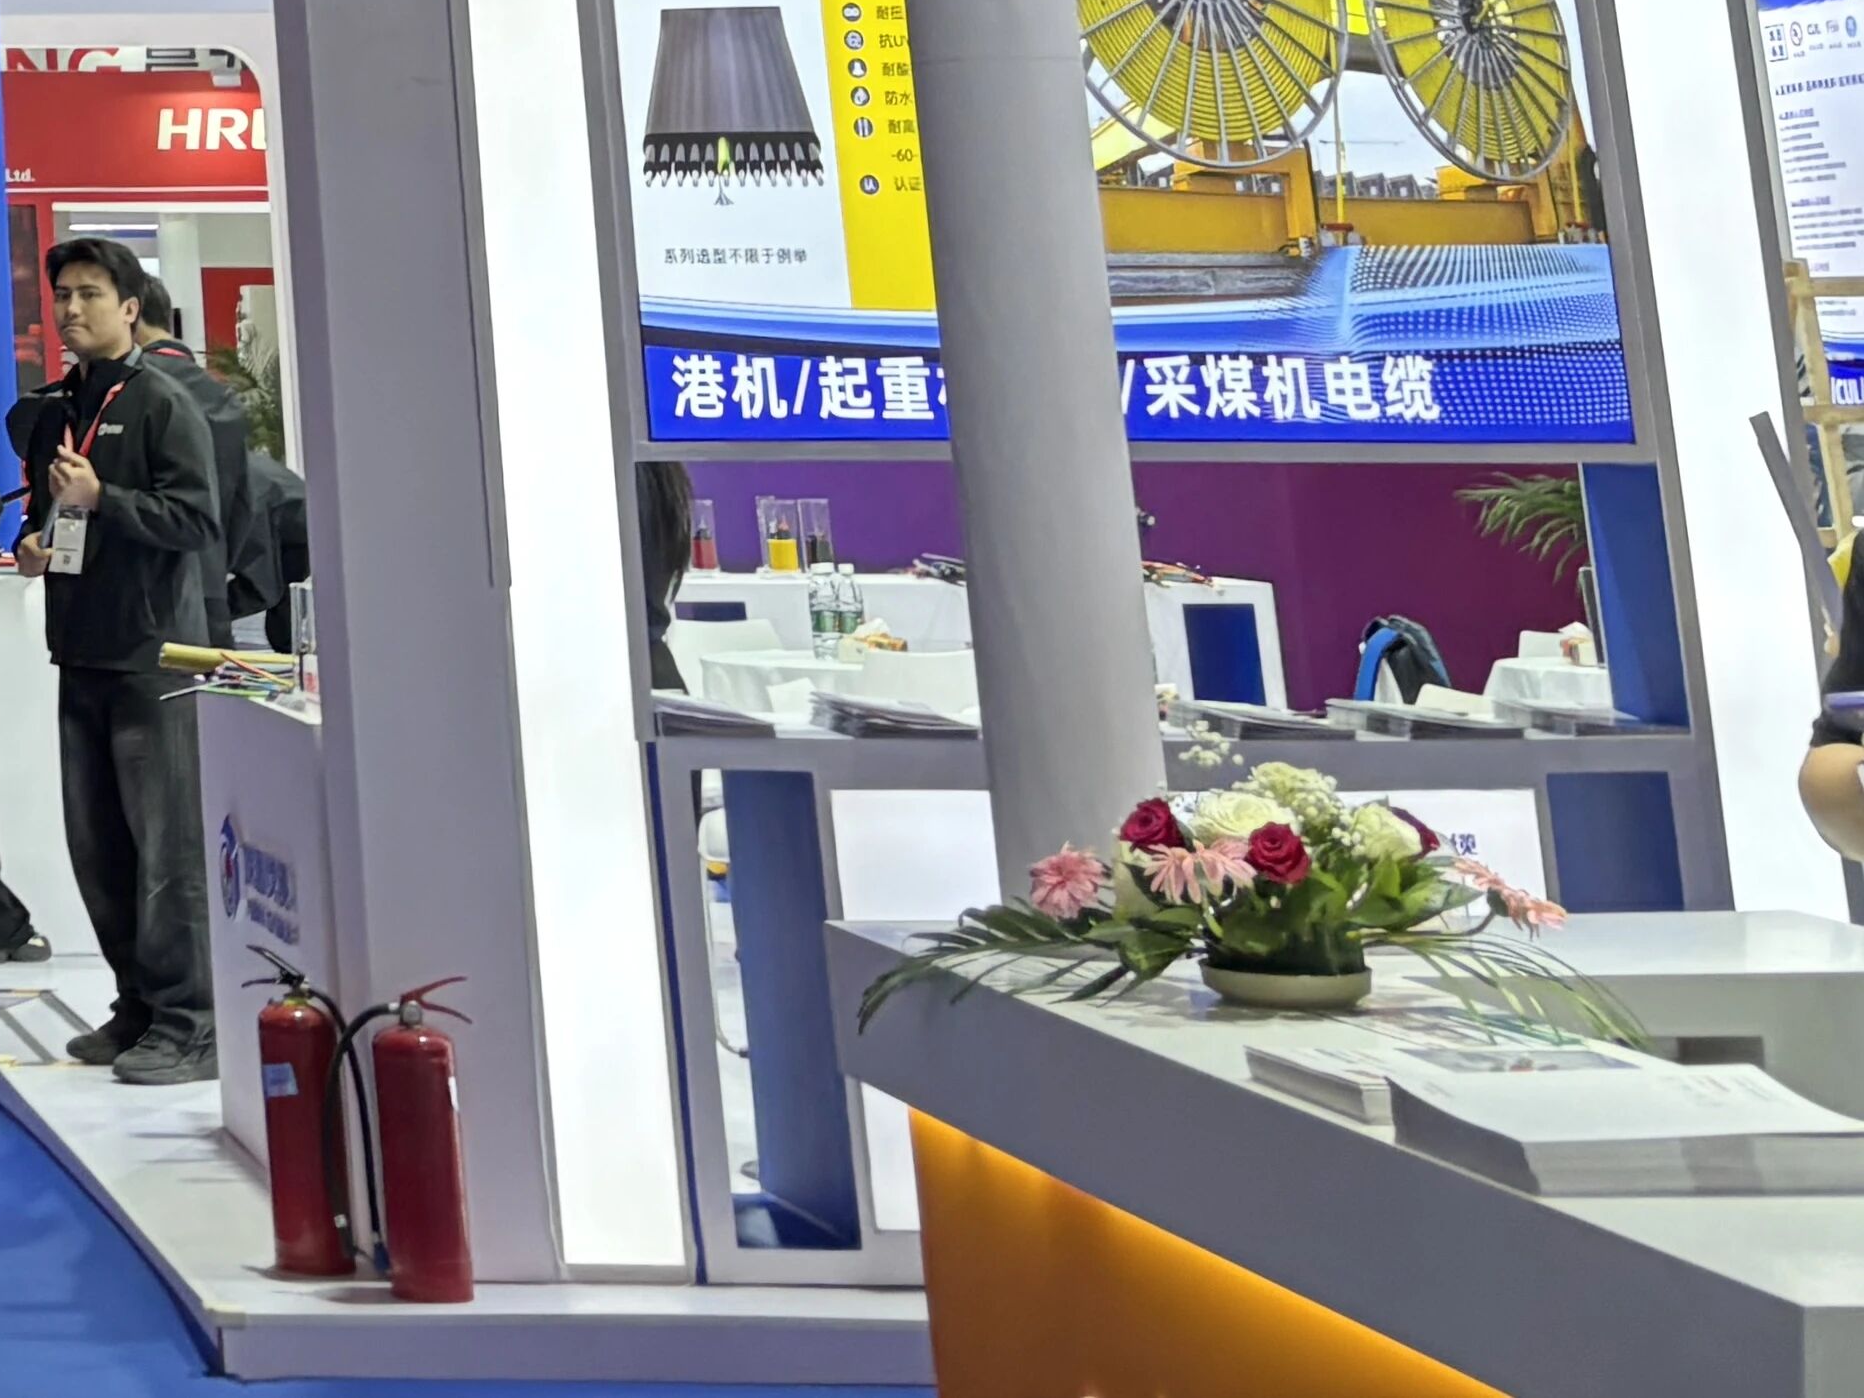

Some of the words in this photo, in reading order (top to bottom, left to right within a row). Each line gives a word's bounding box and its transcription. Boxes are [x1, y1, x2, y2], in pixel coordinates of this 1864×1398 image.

[672, 354, 1441, 423] 港机/起重/采煤机电缆
